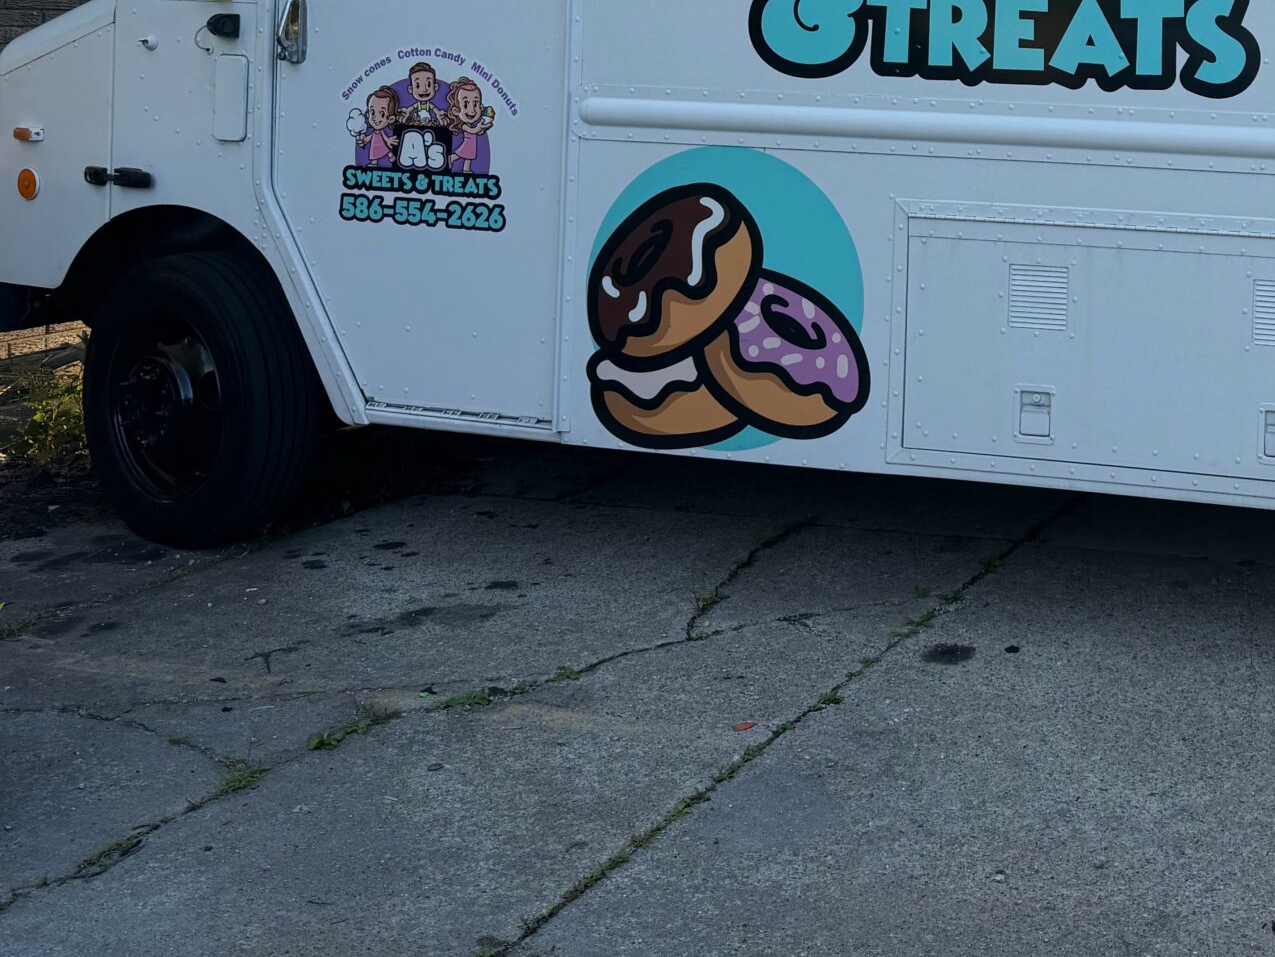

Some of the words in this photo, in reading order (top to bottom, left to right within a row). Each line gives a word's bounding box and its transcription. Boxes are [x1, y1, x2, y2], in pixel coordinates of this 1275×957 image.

[342, 76, 364, 101] Snow
[364, 56, 392, 78] cones
[397, 48, 432, 60] Cotton
[434, 48, 467, 66] Candy
[471, 62, 492, 82] Mini
[491, 78, 519, 117] Donuts
[399, 130, 446, 170] A's
[345, 169, 413, 193] SWEETS
[415, 174, 429, 191] &
[432, 175, 499, 196] TREATS
[341, 195, 504, 230] 586-554-2626
